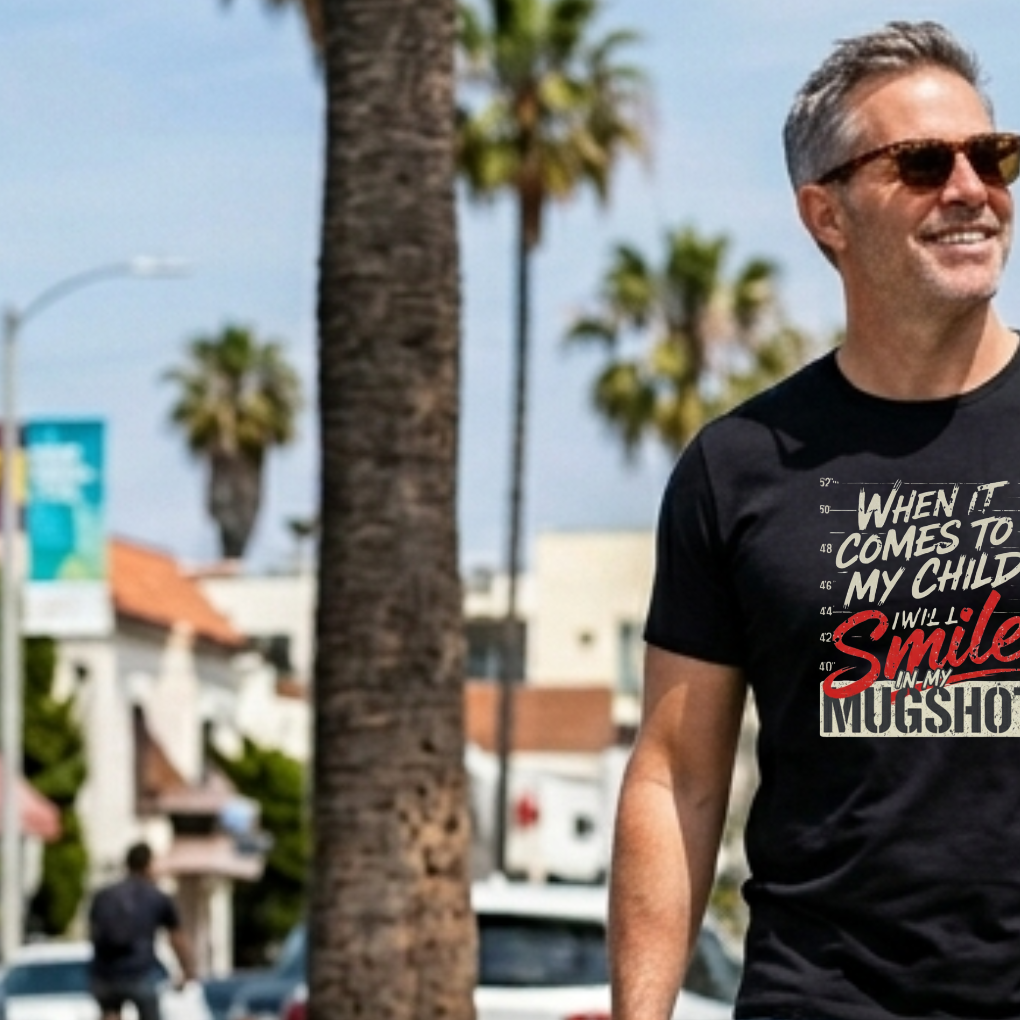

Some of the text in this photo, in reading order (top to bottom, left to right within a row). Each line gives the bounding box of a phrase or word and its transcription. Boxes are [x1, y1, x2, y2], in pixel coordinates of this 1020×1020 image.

[858, 479, 1010, 530] WHEN IT
[835, 516, 1013, 569] COMES TO
[843, 566, 905, 609] MY
[896, 669, 952, 688] IN MY
